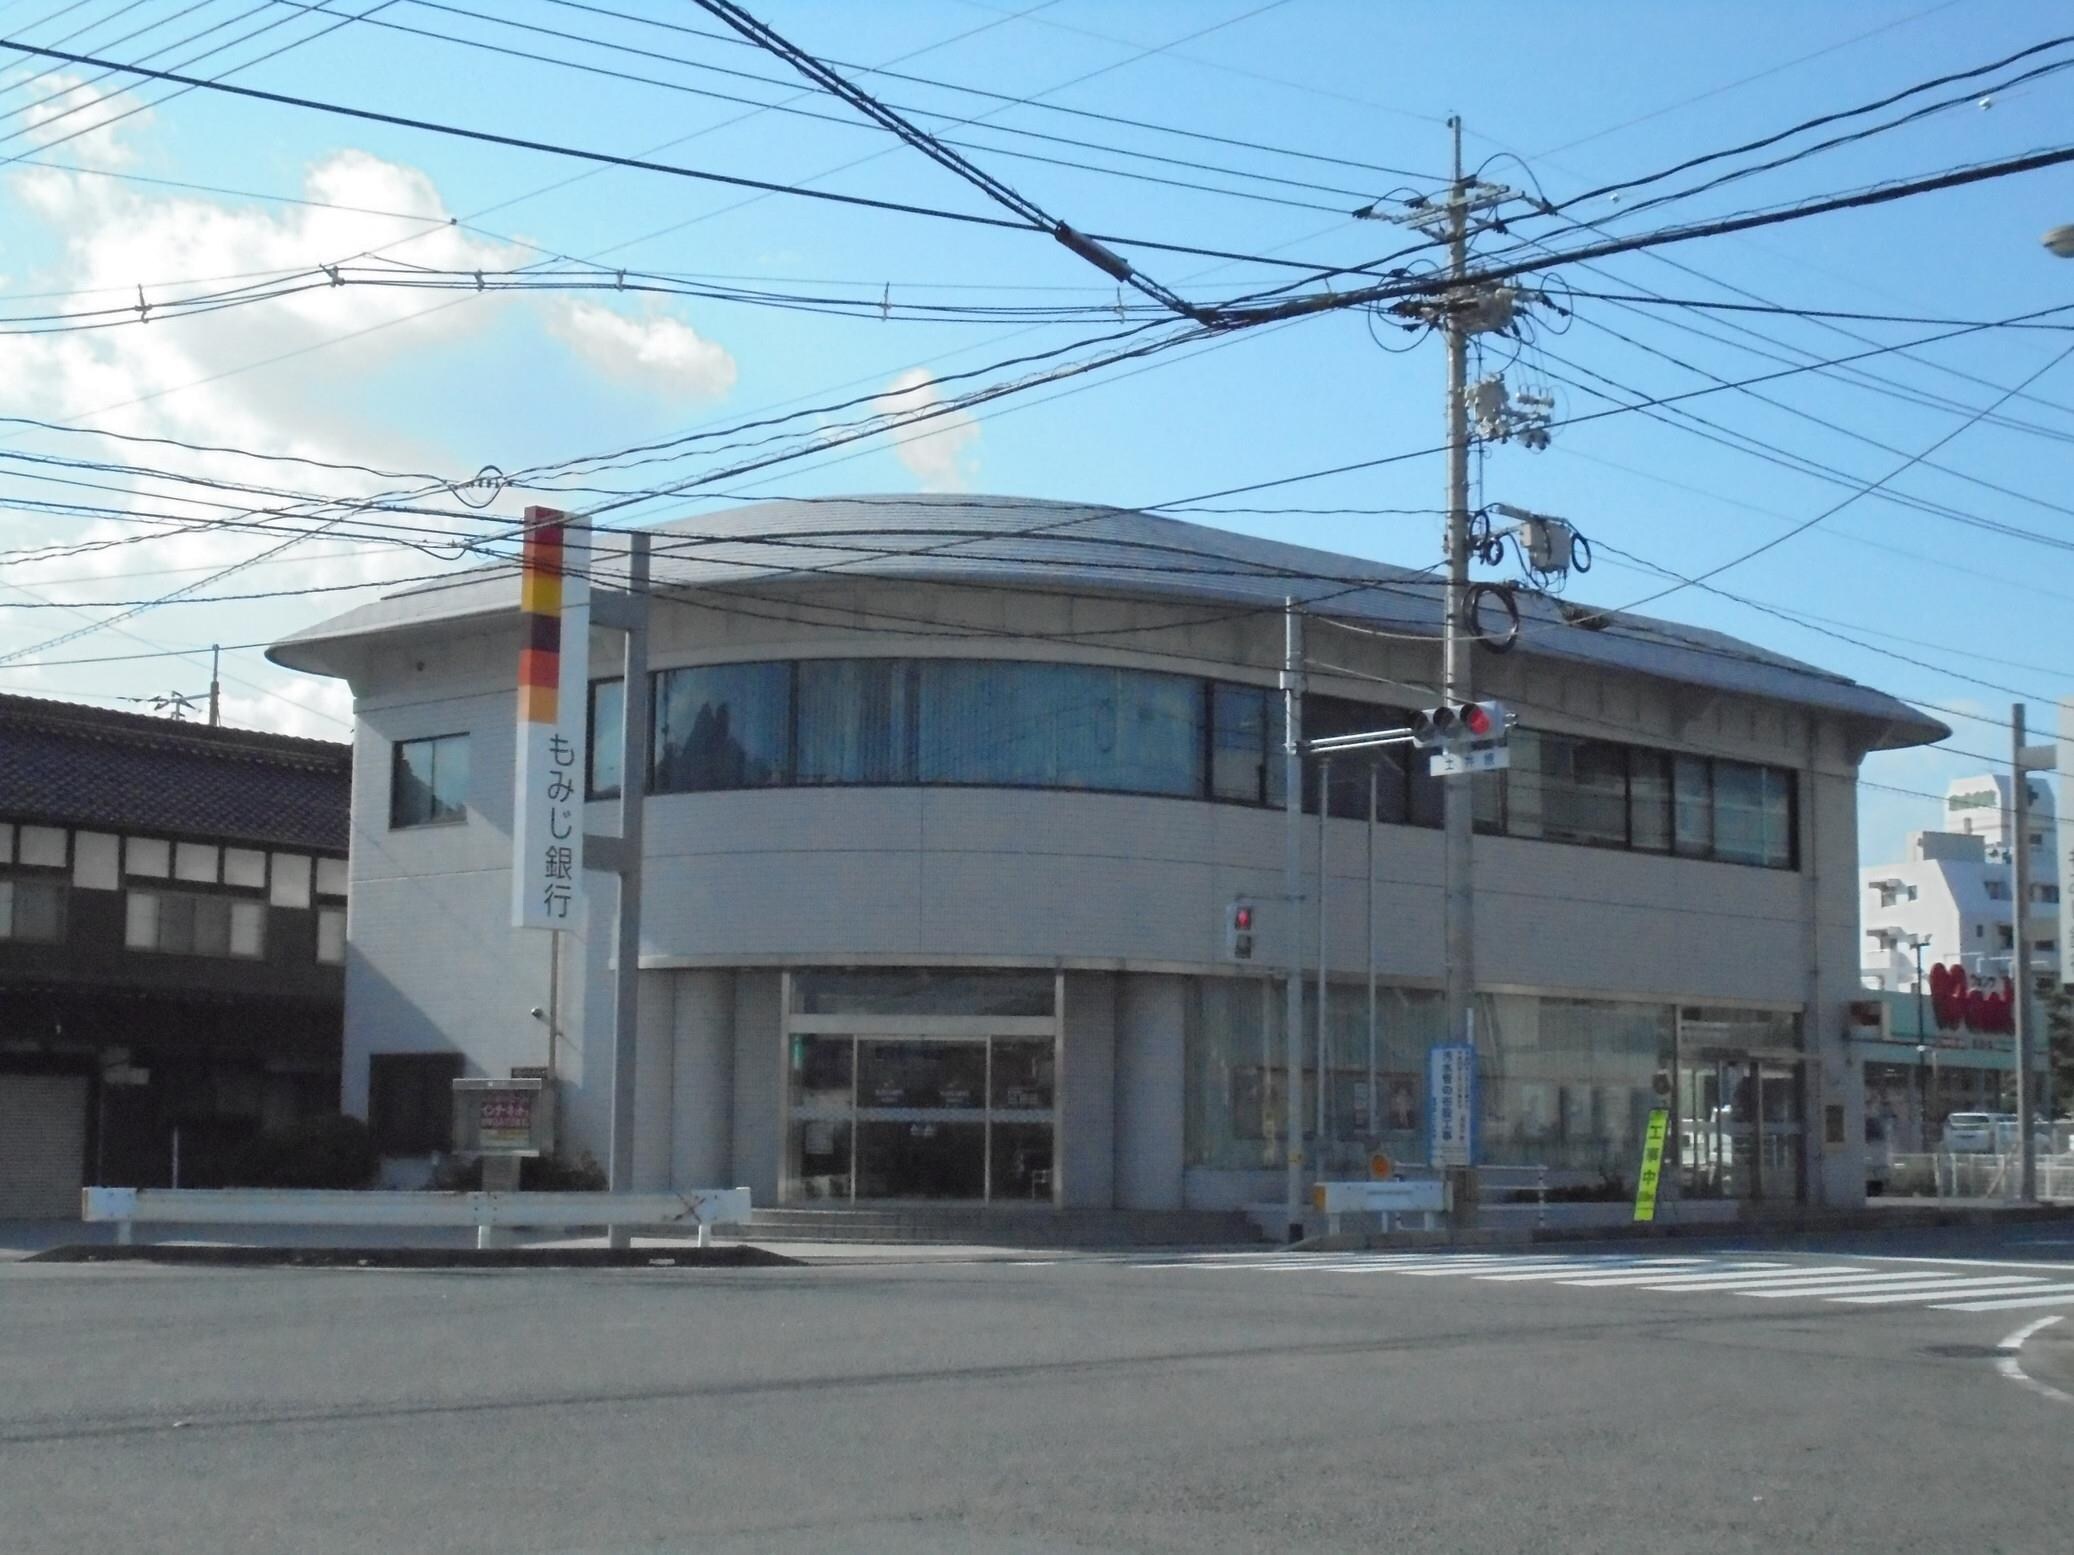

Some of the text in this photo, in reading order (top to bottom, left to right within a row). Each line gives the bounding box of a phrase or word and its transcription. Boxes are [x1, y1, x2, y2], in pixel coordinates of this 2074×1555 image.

[543, 733, 575, 919] もみじ銀行
